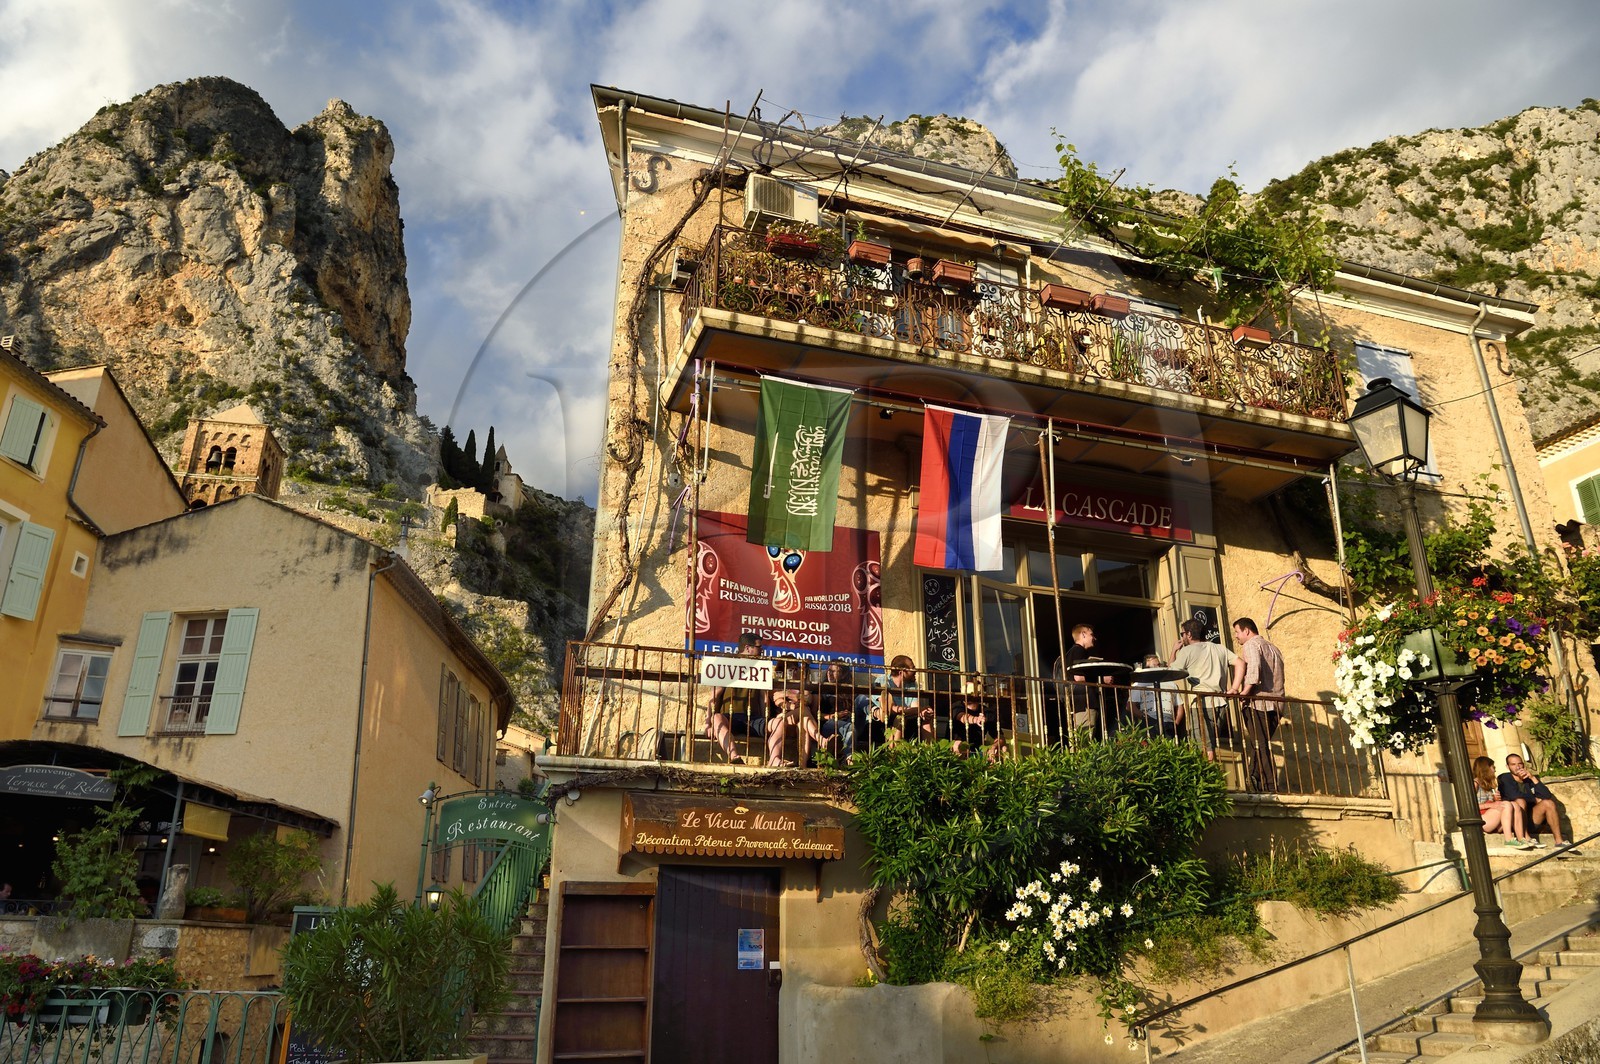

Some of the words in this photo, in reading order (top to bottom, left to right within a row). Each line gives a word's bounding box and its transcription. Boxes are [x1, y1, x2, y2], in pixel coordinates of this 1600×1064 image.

[1062, 492, 1173, 529] CASCADE
[720, 578, 740, 591] FIFA
[740, 584, 760, 596] WORLD
[720, 590, 756, 603] RUSSIA
[756, 597, 769, 605] 2018
[814, 594, 833, 602] WORLD
[834, 593, 850, 601] CUP
[804, 602, 828, 611] RUSSIA
[828, 603, 852, 613] 2018
[741, 615, 765, 626] FIFA
[767, 617, 807, 630] WORLD
[808, 622, 830, 632] CUP
[741, 627, 797, 642] RUSSIA
[798, 633, 832, 646] 2018
[705, 663, 770, 682] OUVERT
[25, 767, 76, 777] Bienvenue
[6, 775, 48, 789] Terrasse
[53, 776, 71, 790] du
[74, 779, 110, 794] Relais
[478, 798, 517, 810] Entrée
[446, 817, 541, 842] Restaurant
[681, 811, 701, 828] Le
[704, 812, 747, 829] Vieux
[750, 814, 796, 831] Moulin
[694, 834, 732, 848] Poterie
